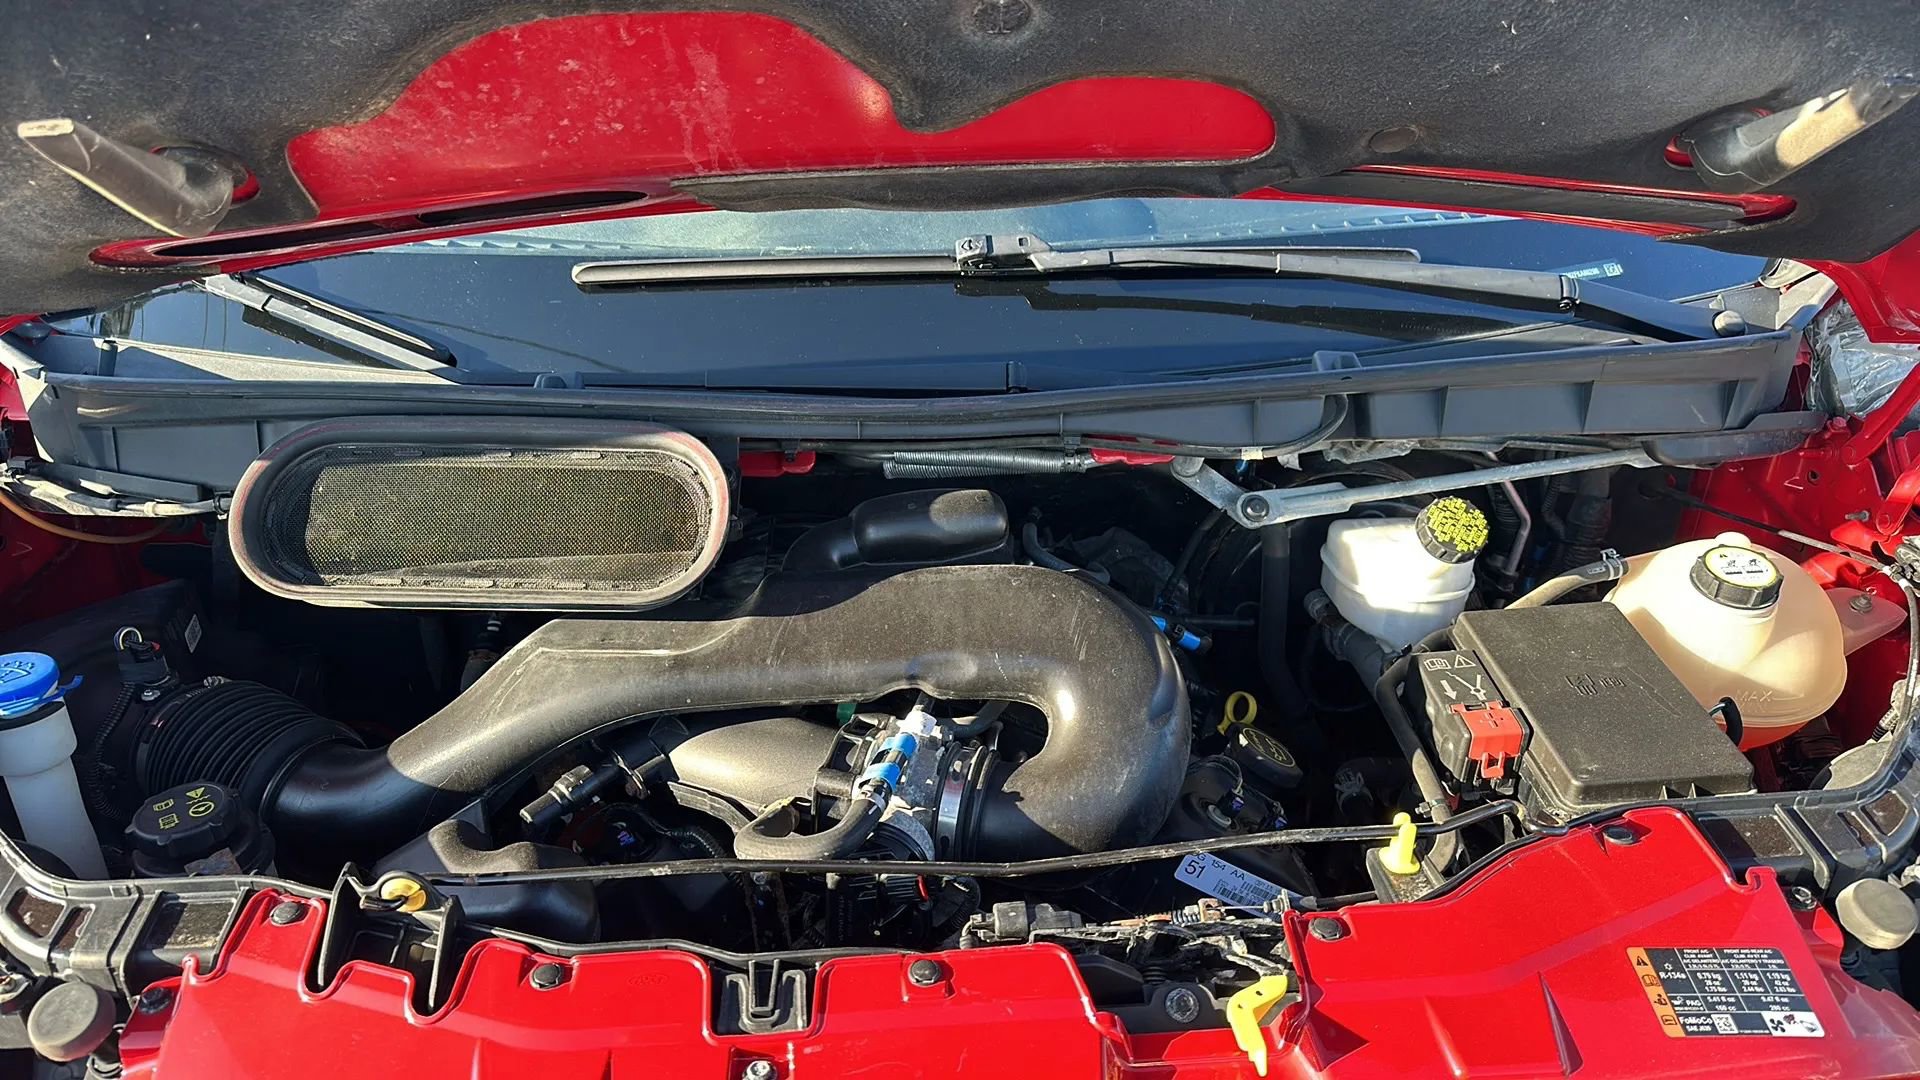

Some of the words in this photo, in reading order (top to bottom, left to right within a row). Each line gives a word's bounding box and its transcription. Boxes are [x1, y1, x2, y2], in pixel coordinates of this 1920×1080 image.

[1735, 689, 1773, 702] MAX
[1184, 859, 1206, 879] 51
[1211, 859, 1226, 871] 154
[1230, 869, 1245, 881] AA
[1659, 971, 1687, 979] R-134a
[1711, 972, 1722, 981] kg
[1748, 972, 1759, 981] kg
[1780, 972, 1791, 981] kg
[1678, 1016, 1714, 1024] FoMoCo
